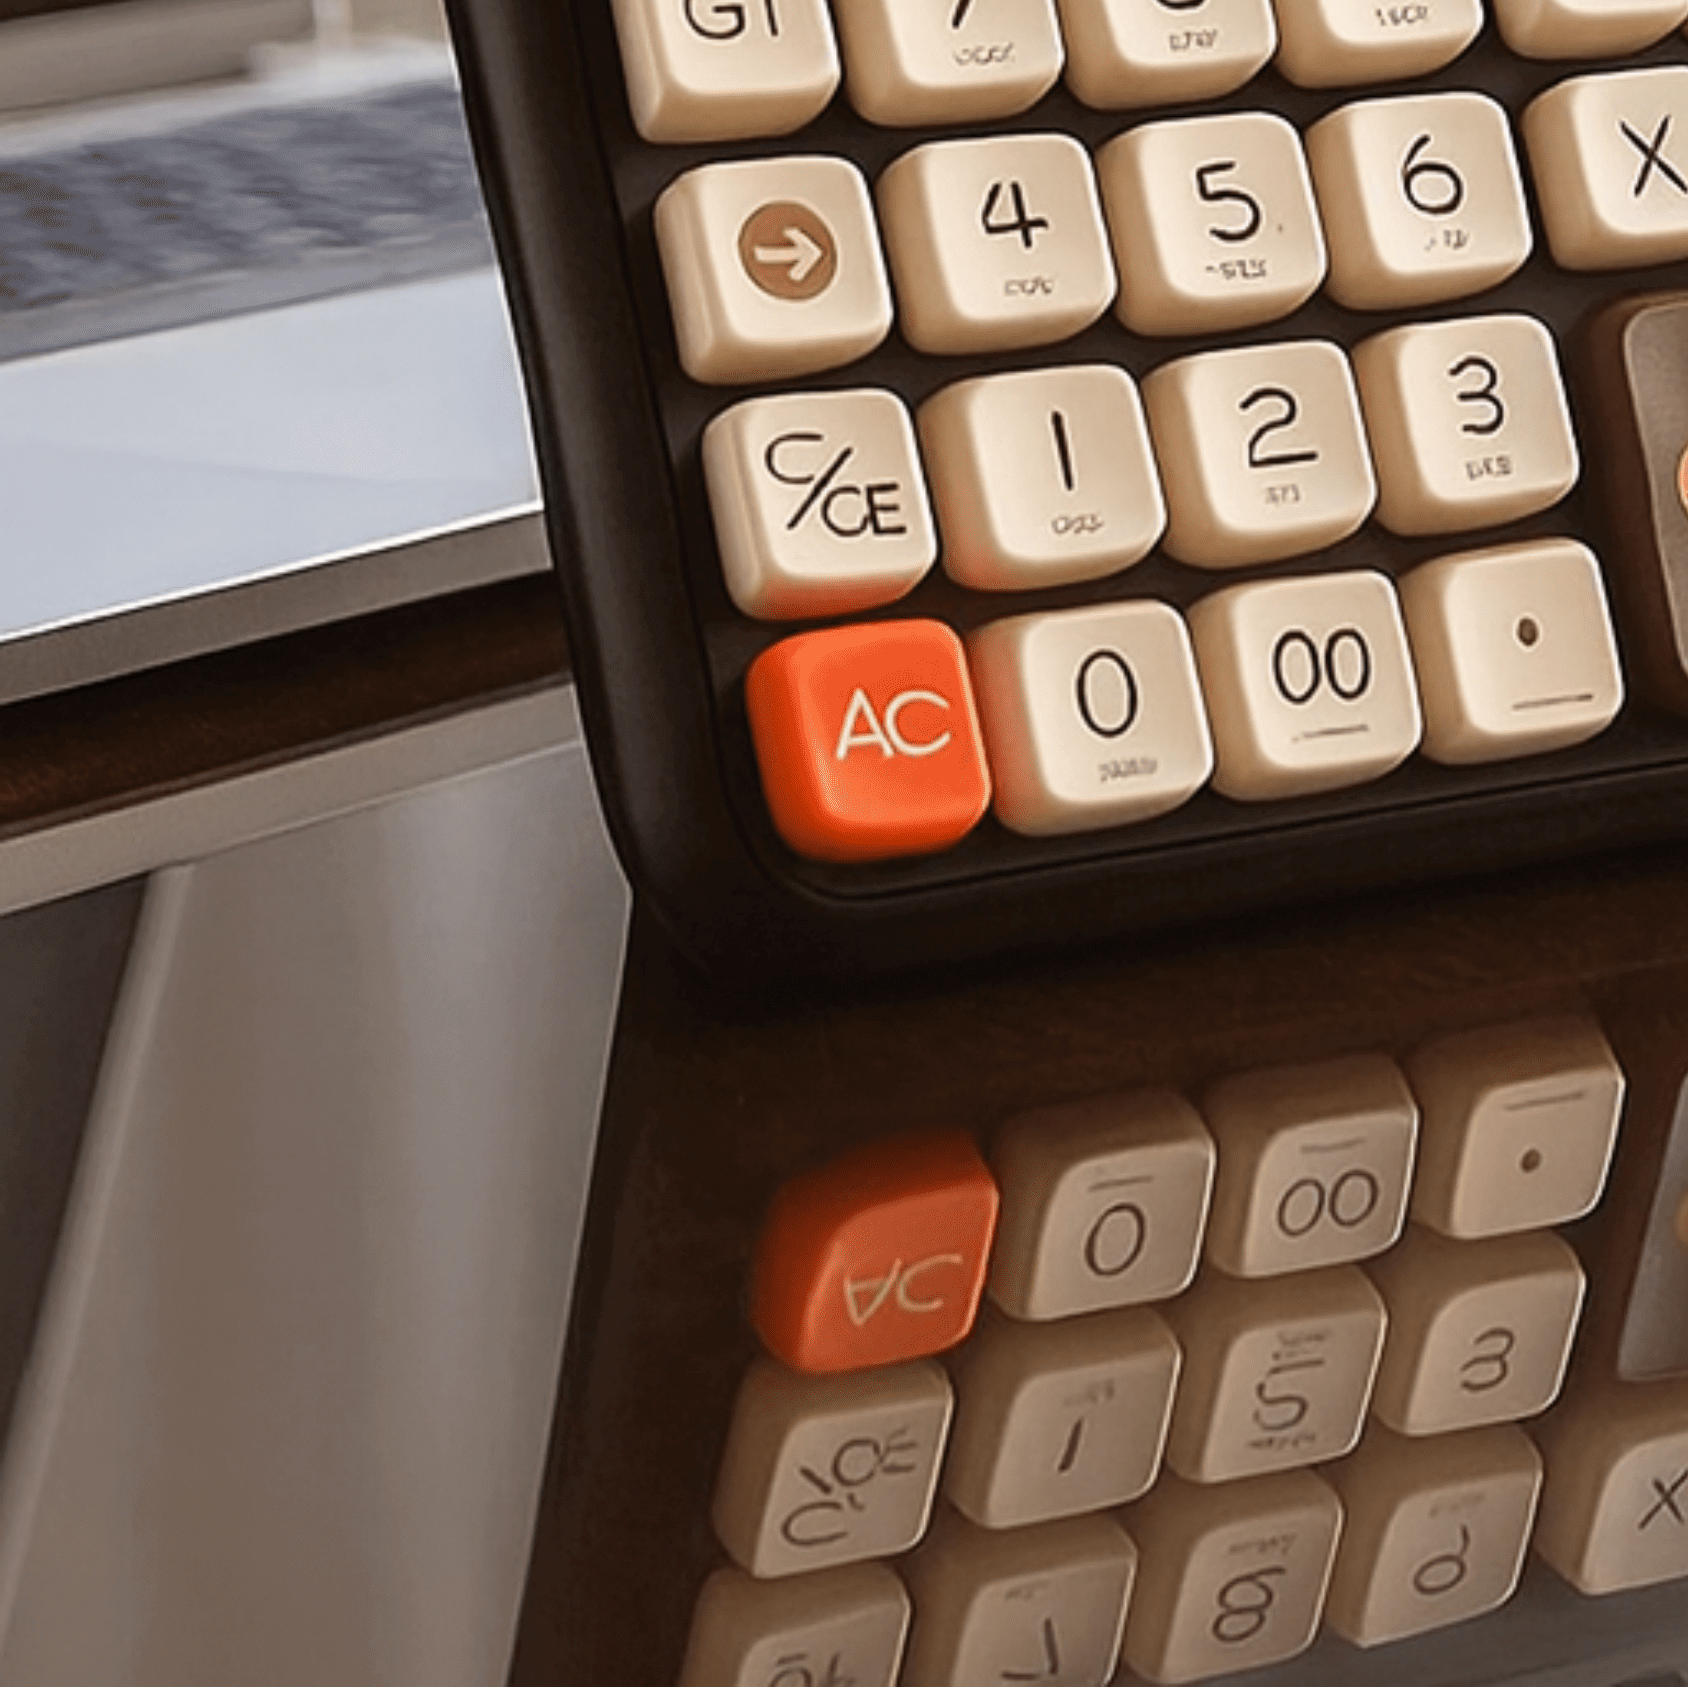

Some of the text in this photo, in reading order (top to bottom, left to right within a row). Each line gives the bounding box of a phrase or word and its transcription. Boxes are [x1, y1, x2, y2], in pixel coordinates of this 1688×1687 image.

[982, 180, 1048, 248] 4
[1196, 161, 1262, 241] 5
[1403, 134, 1464, 215] 6
[1240, 387, 1319, 468] 2
[1448, 356, 1504, 435] 3
[1077, 649, 1138, 739] 0
[1272, 628, 1370, 703] 00
[836, 689, 952, 760] AC
